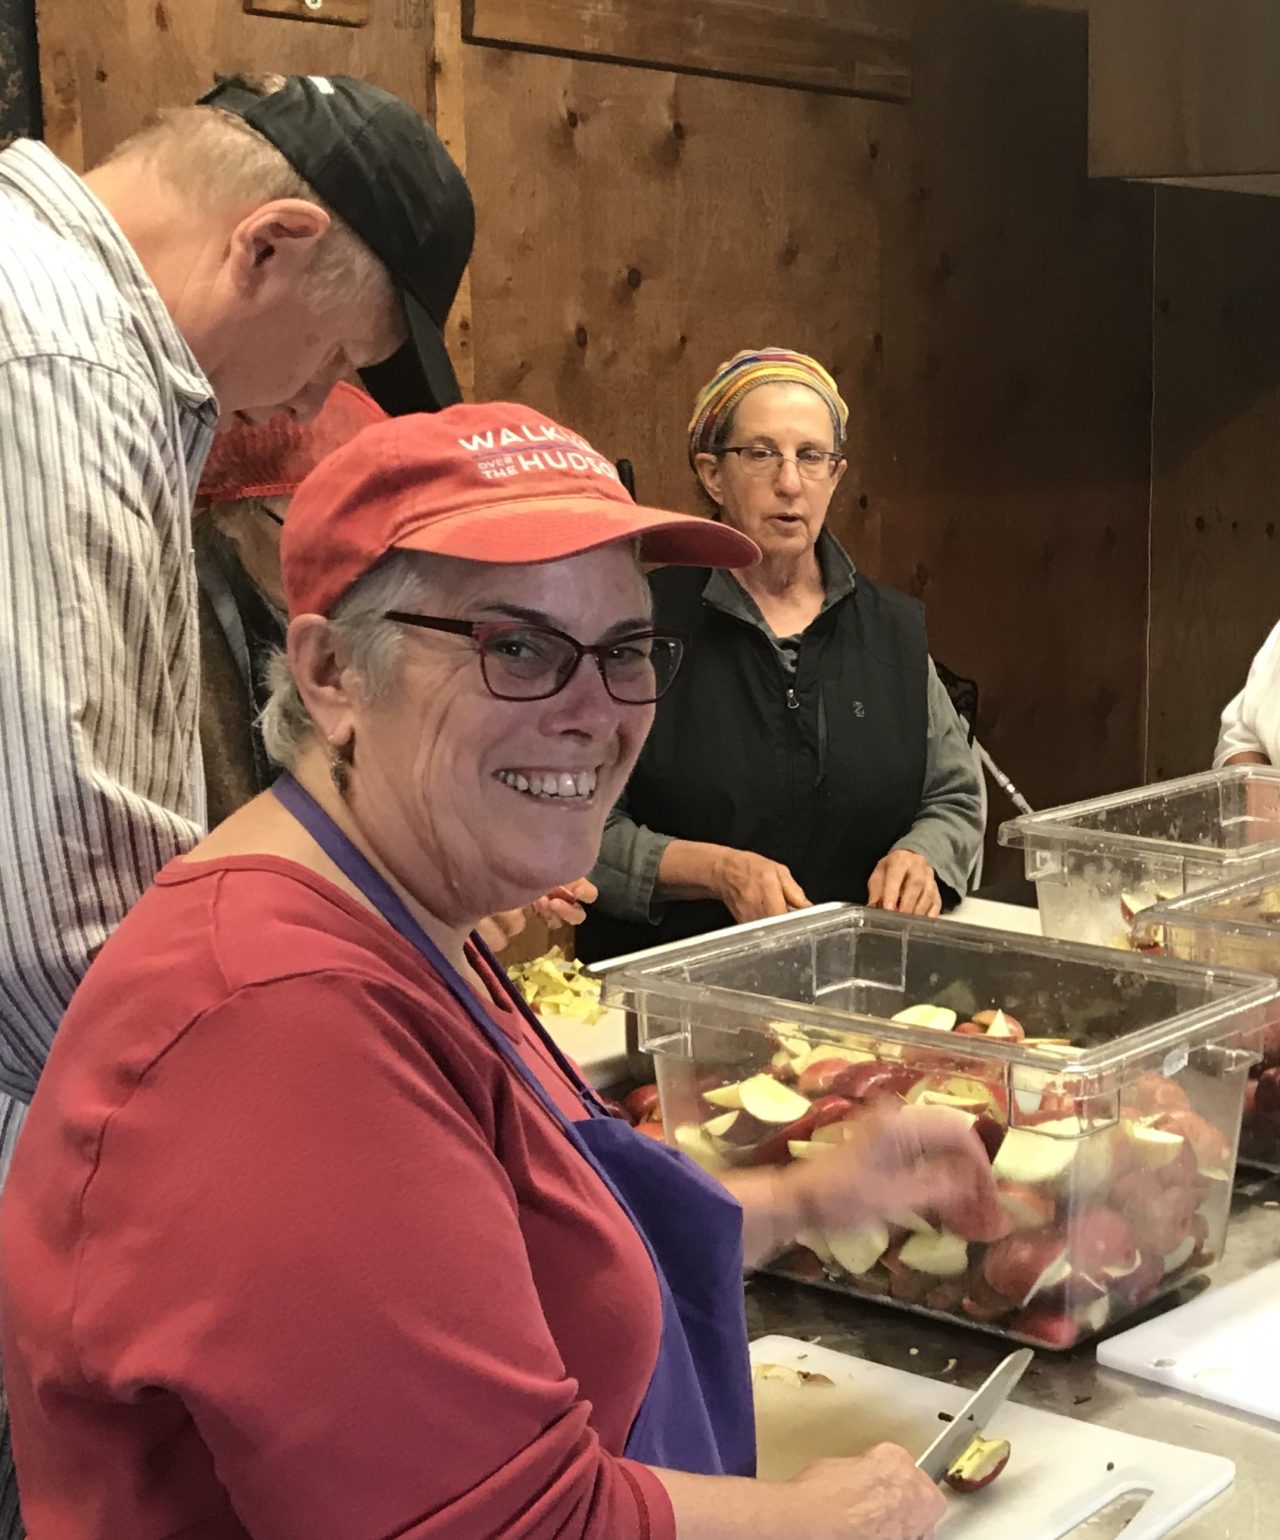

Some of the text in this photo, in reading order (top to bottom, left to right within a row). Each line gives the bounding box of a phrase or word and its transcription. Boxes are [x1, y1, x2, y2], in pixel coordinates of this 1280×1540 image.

[478, 457, 513, 470] OVER
[482, 451, 618, 480] THE HUDSO
